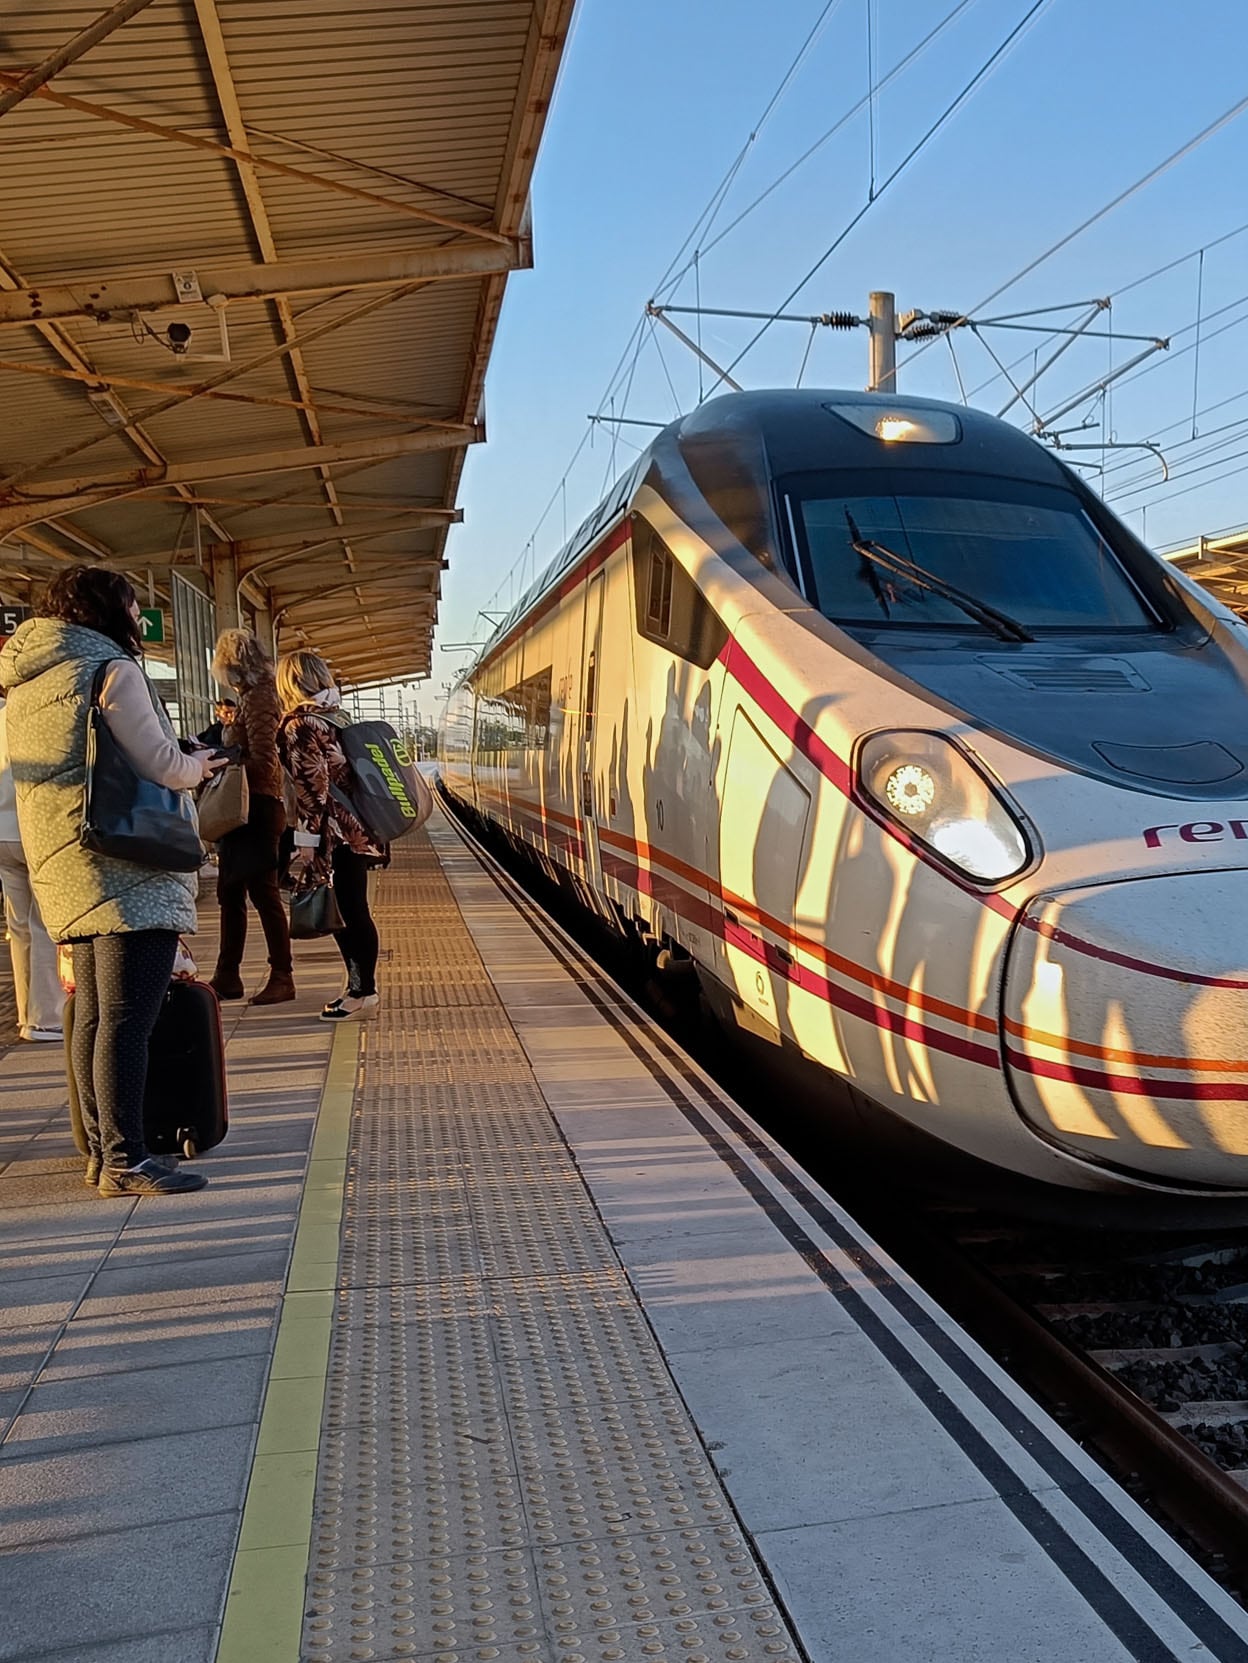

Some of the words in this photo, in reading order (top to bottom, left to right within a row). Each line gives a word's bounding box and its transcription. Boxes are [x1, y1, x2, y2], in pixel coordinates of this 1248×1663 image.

[4, 612, 17, 634] 5
[364, 743, 417, 818] Bullpadel
[656, 799, 664, 831] 10
